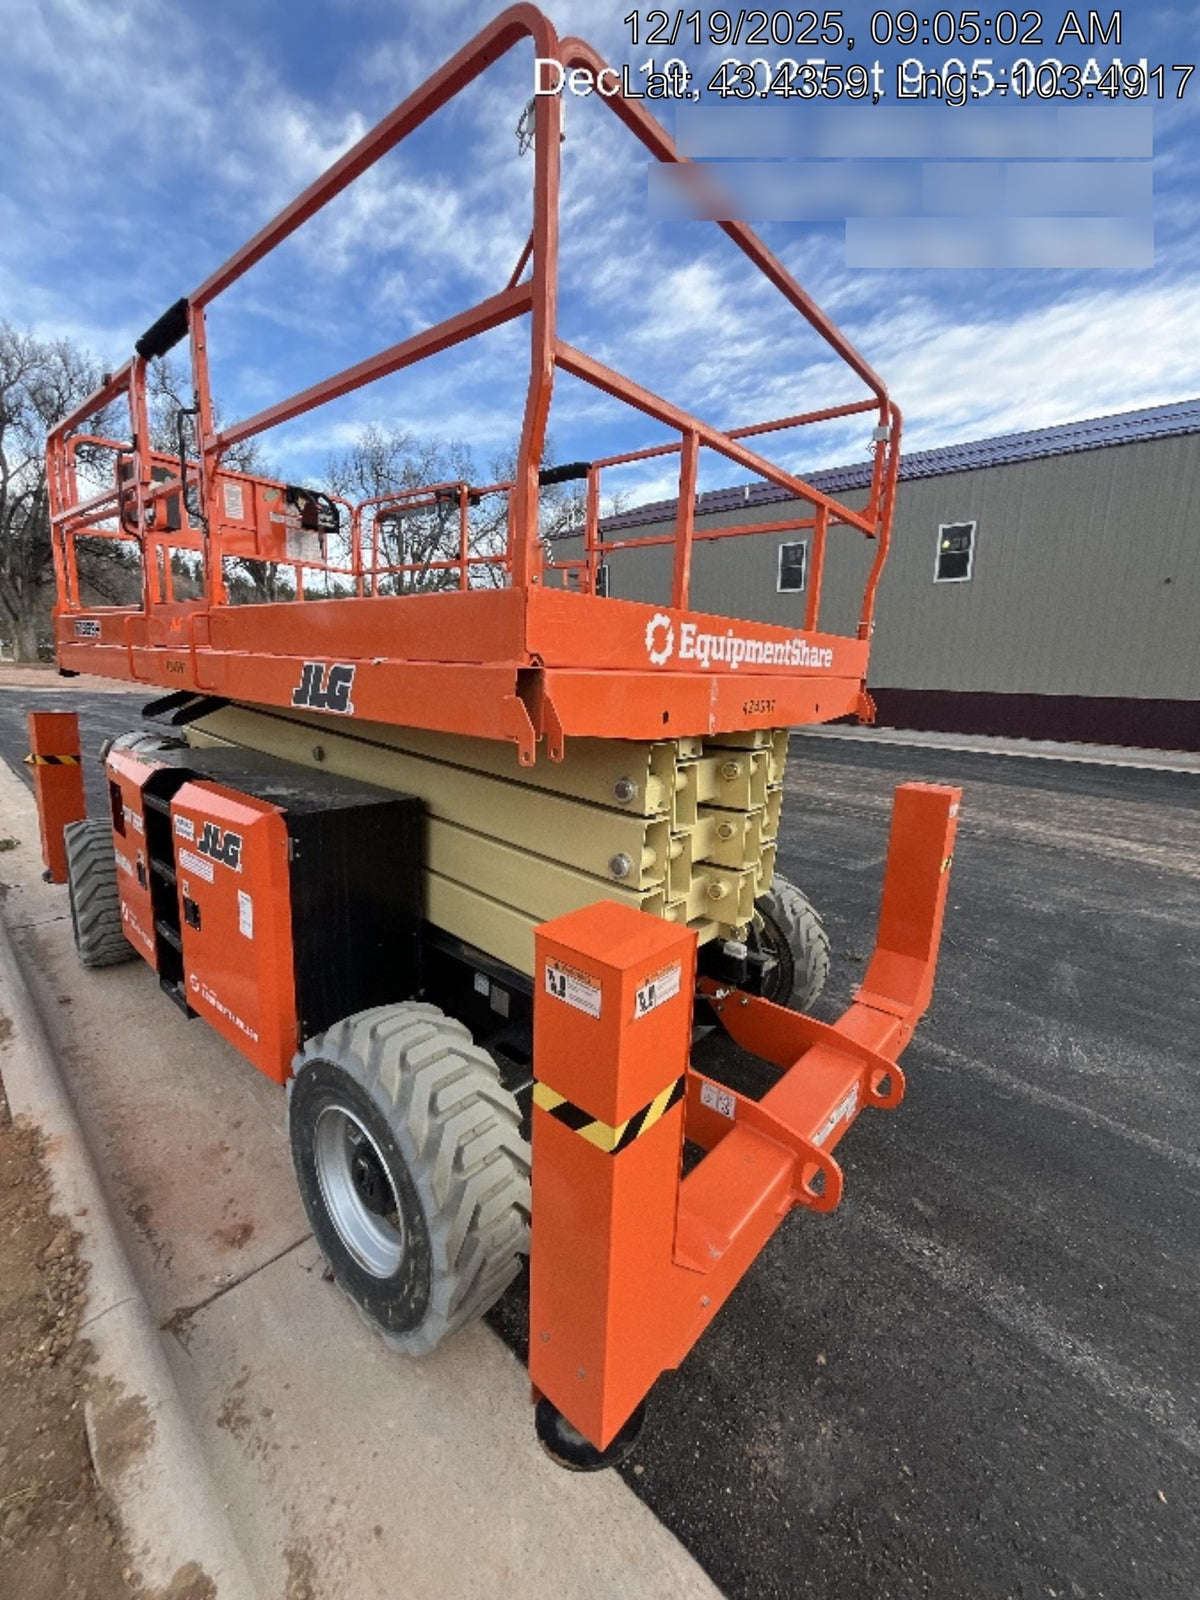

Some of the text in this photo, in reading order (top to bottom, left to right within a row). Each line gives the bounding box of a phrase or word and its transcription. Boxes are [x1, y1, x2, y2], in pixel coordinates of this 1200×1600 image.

[678, 622, 833, 669] EquipmentShare
[291, 661, 356, 715] JLG
[196, 821, 244, 873] JLG
